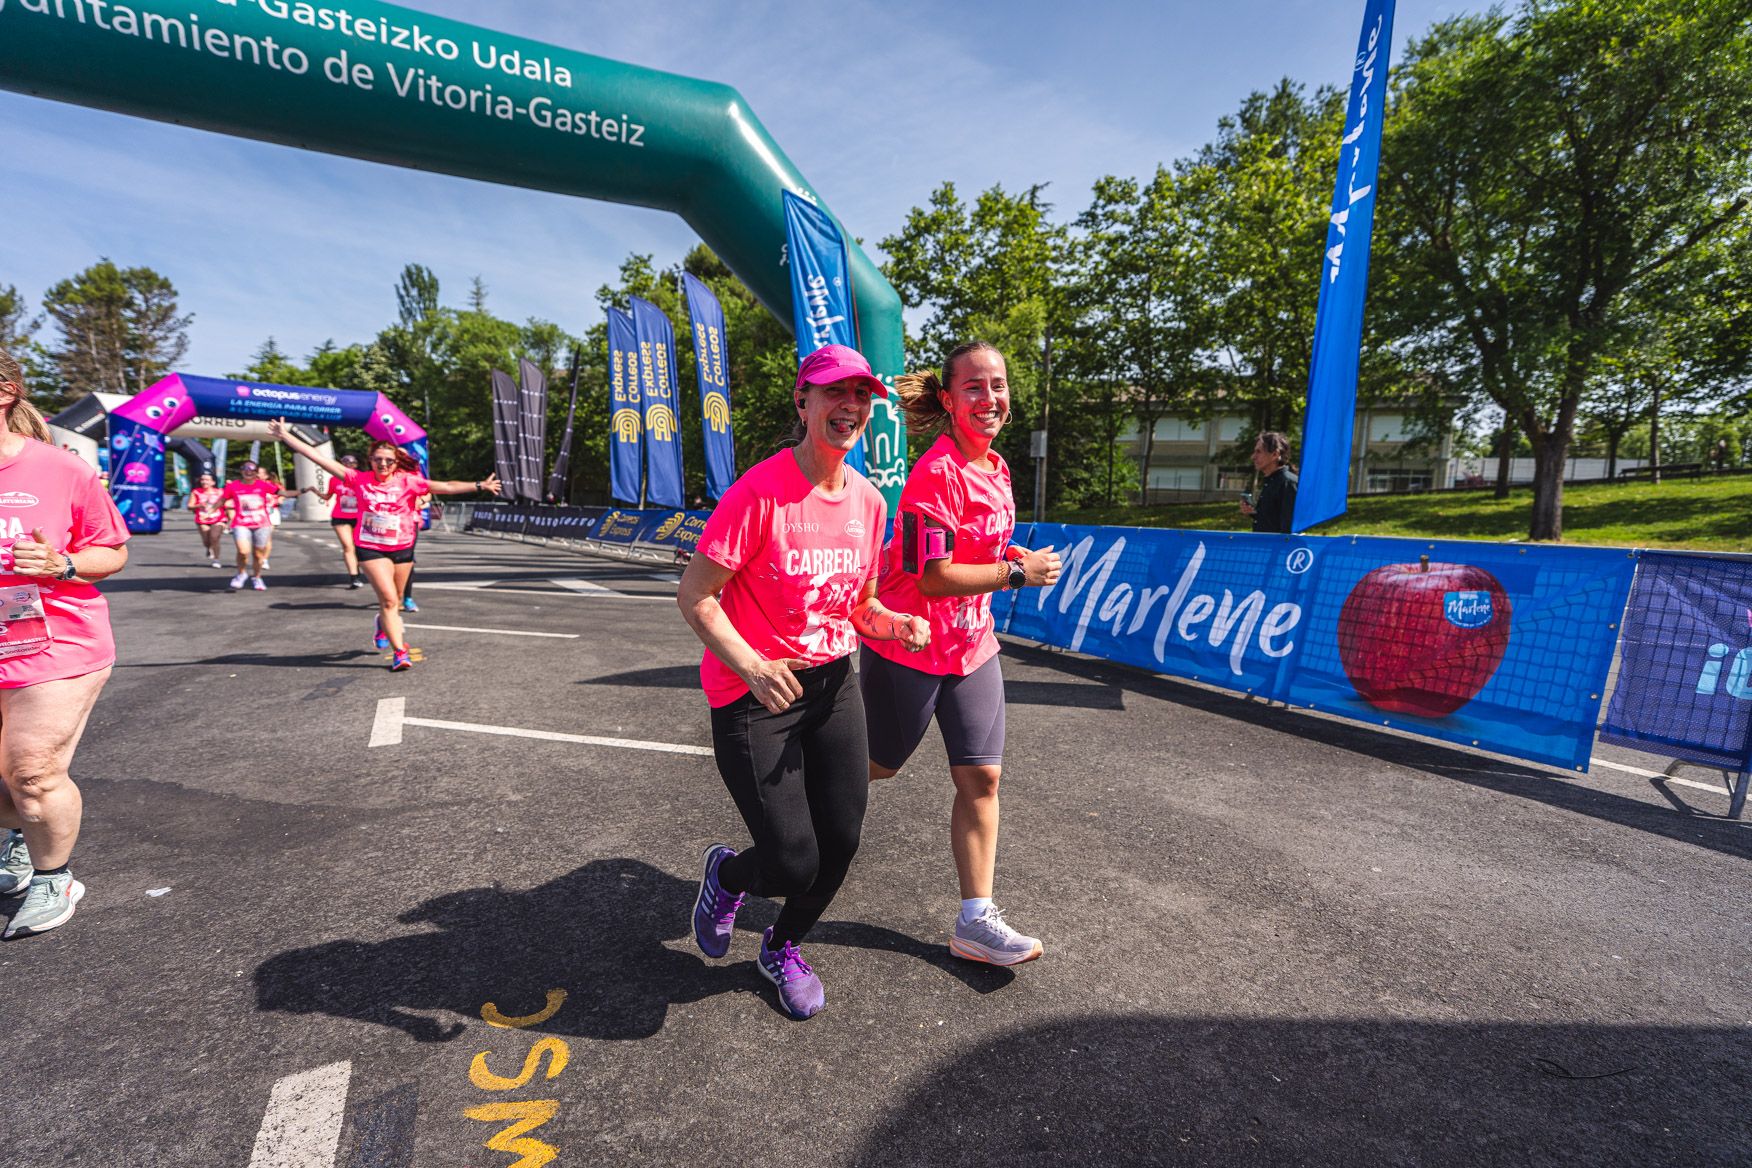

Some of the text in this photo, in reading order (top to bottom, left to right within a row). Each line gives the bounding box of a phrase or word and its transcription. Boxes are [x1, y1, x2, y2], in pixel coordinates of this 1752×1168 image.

[472, 41, 572, 88] Udala
[323, 50, 375, 91] de
[385, 62, 646, 147] Vitoria-Gasteiz
[782, 522, 819, 534] OYSHO
[1037, 535, 1301, 676] Marlene
[1447, 599, 1491, 620] Marlene
